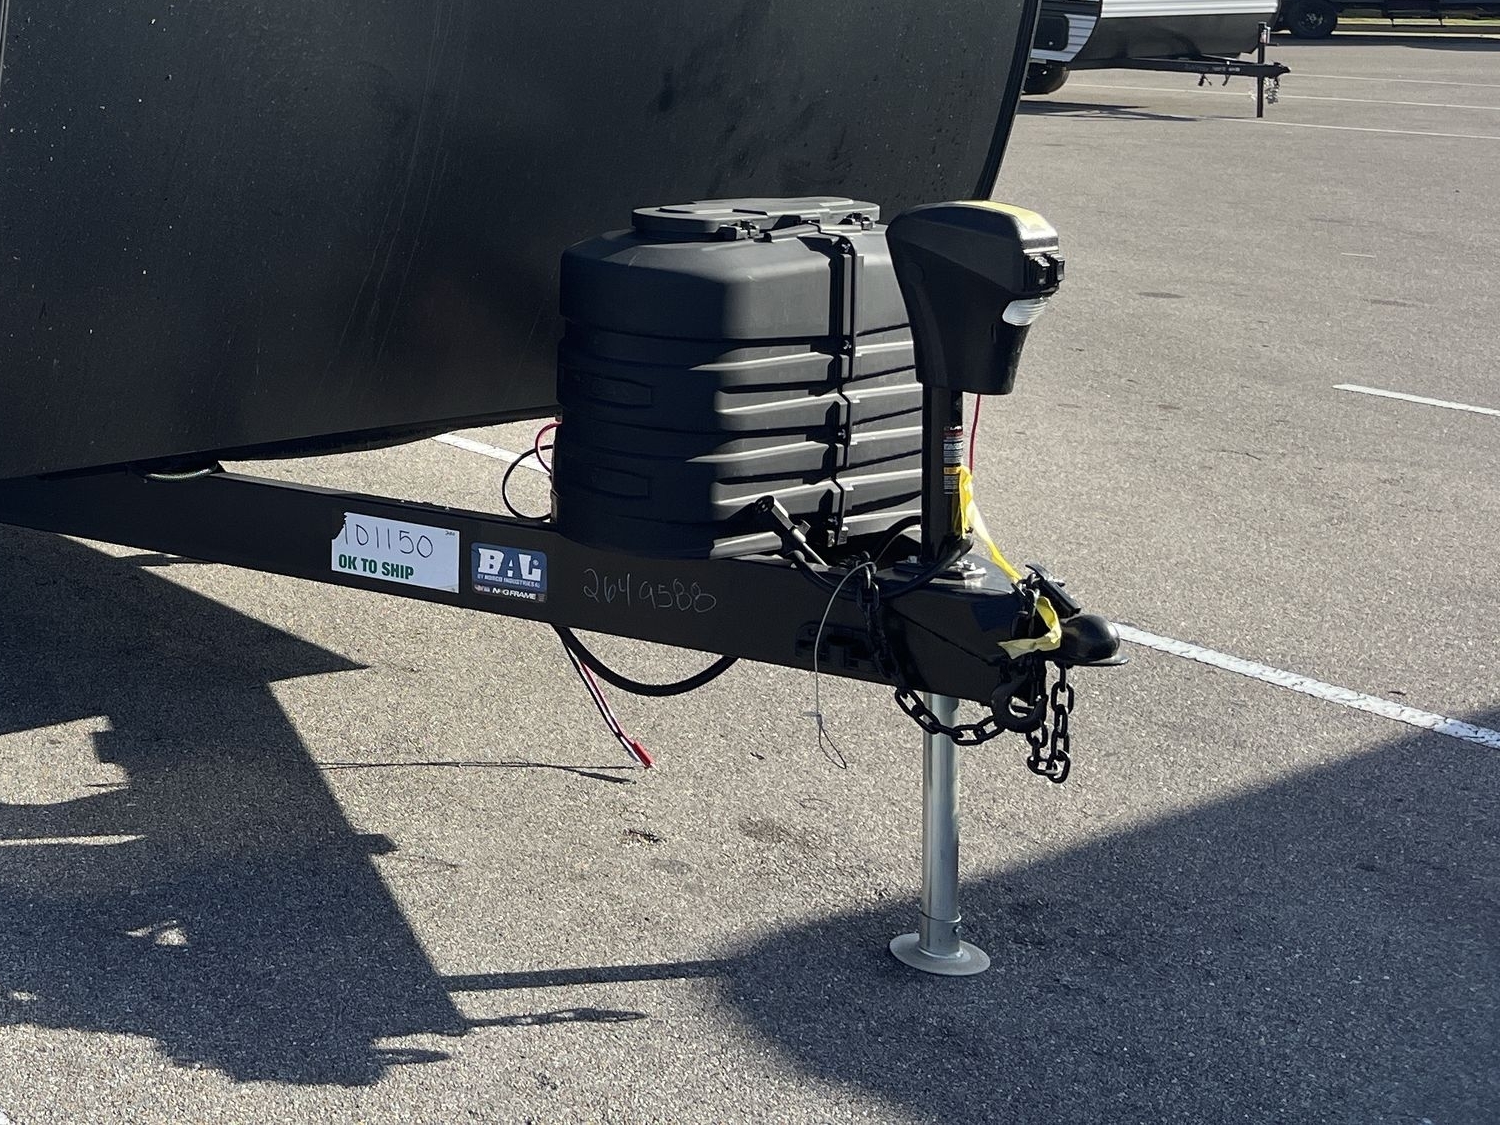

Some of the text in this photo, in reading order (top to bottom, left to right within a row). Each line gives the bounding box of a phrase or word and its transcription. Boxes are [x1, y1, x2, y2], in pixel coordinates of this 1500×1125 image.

[344, 523, 433, 558] 101150
[339, 554, 415, 580] OK TO SHIP
[478, 548, 541, 581] BAL
